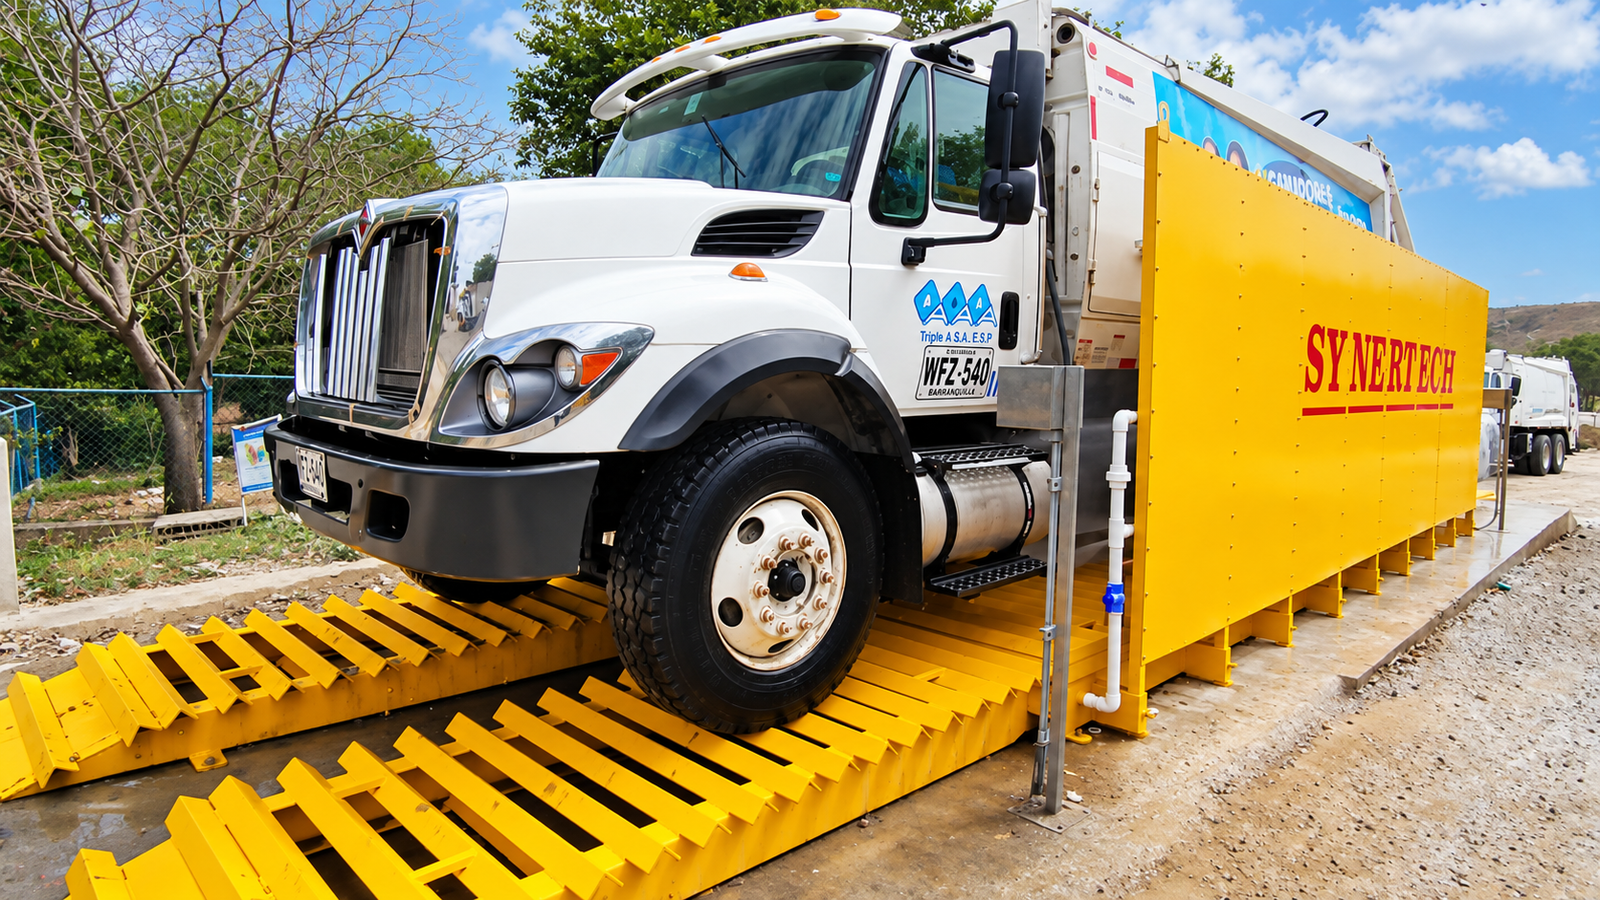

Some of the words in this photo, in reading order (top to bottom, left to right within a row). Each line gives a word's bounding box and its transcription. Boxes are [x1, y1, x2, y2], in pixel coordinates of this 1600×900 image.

[920, 330, 943, 344] Triple
[945, 331, 952, 343] A
[1304, 323, 1457, 394] SYNERTECH
